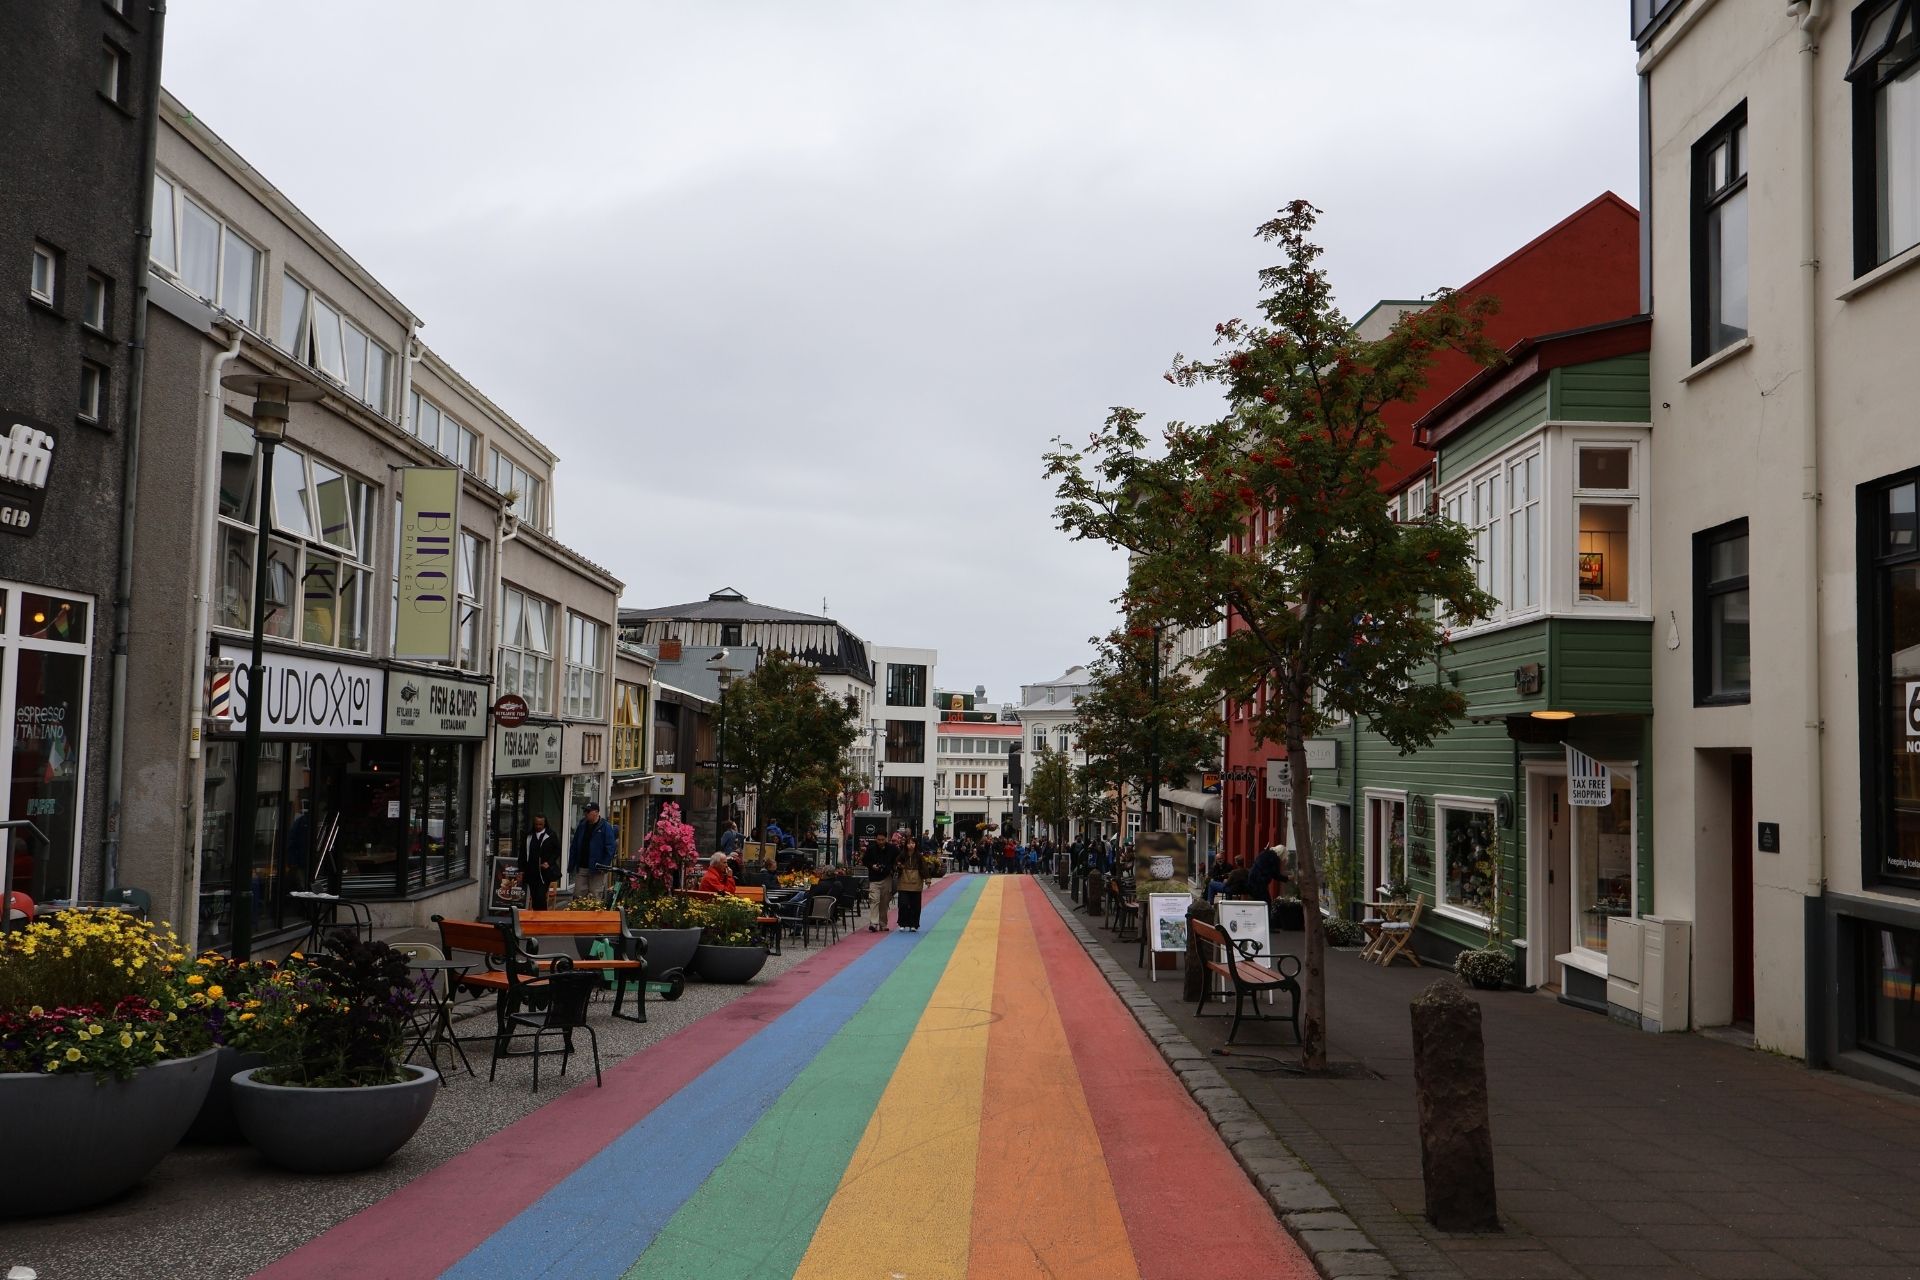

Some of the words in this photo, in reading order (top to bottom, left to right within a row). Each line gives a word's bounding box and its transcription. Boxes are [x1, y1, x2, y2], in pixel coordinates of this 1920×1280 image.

[404, 523, 415, 601] DRINKERY
[414, 511, 451, 614] BINGO
[233, 662, 329, 726] SUDIO
[430, 685, 448, 715] FISH
[449, 689, 456, 716] &
[456, 688, 478, 718] CHIPS
[440, 718, 467, 731] RESTAURANT
[504, 731, 518, 757] FISH
[518, 733, 523, 756] &
[523, 732, 539, 756] CHIPS
[1572, 779, 1586, 789] TAX
[1588, 780, 1606, 789] FREE
[1572, 789, 1607, 799] SHOPPING
[1887, 856, 1907, 869] Keeping
